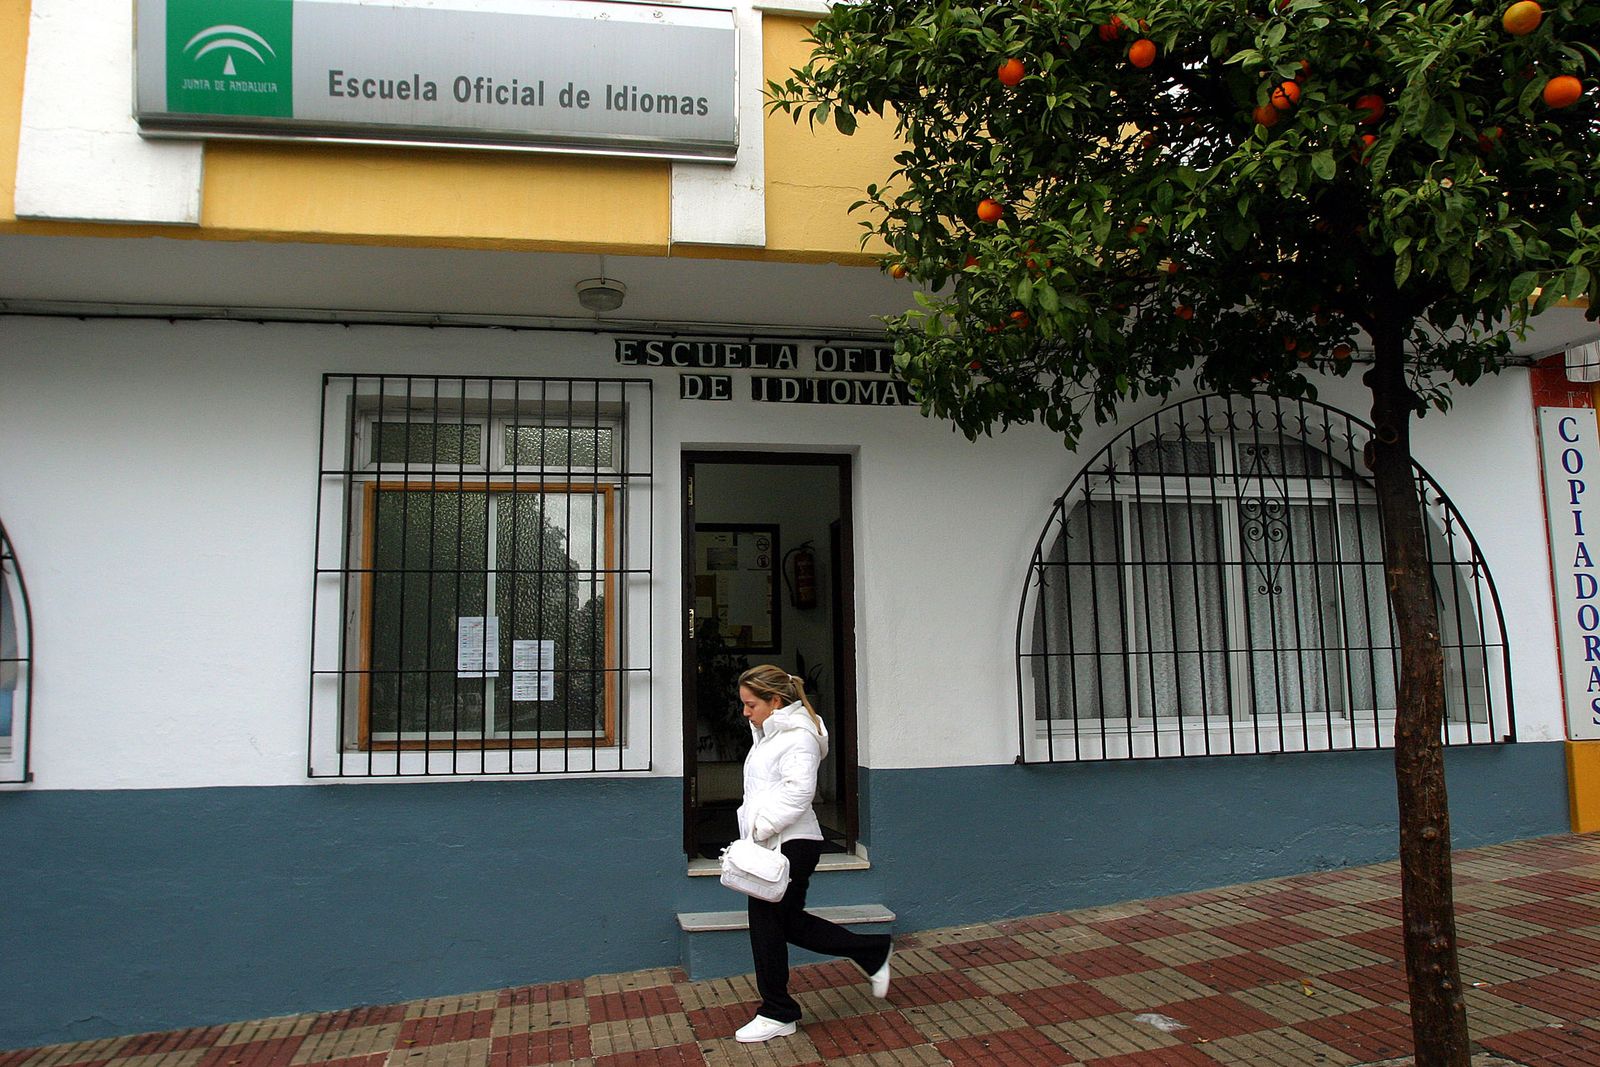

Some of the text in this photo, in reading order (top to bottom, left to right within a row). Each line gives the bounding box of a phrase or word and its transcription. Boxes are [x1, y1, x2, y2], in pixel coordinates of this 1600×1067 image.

[182, 79, 211, 90] JUNTA
[214, 80, 225, 91] DE
[329, 69, 709, 116] Escuela Oficial de Idiomas
[618, 340, 902, 373] ESCUELA OFI
[682, 375, 729, 400] DE
